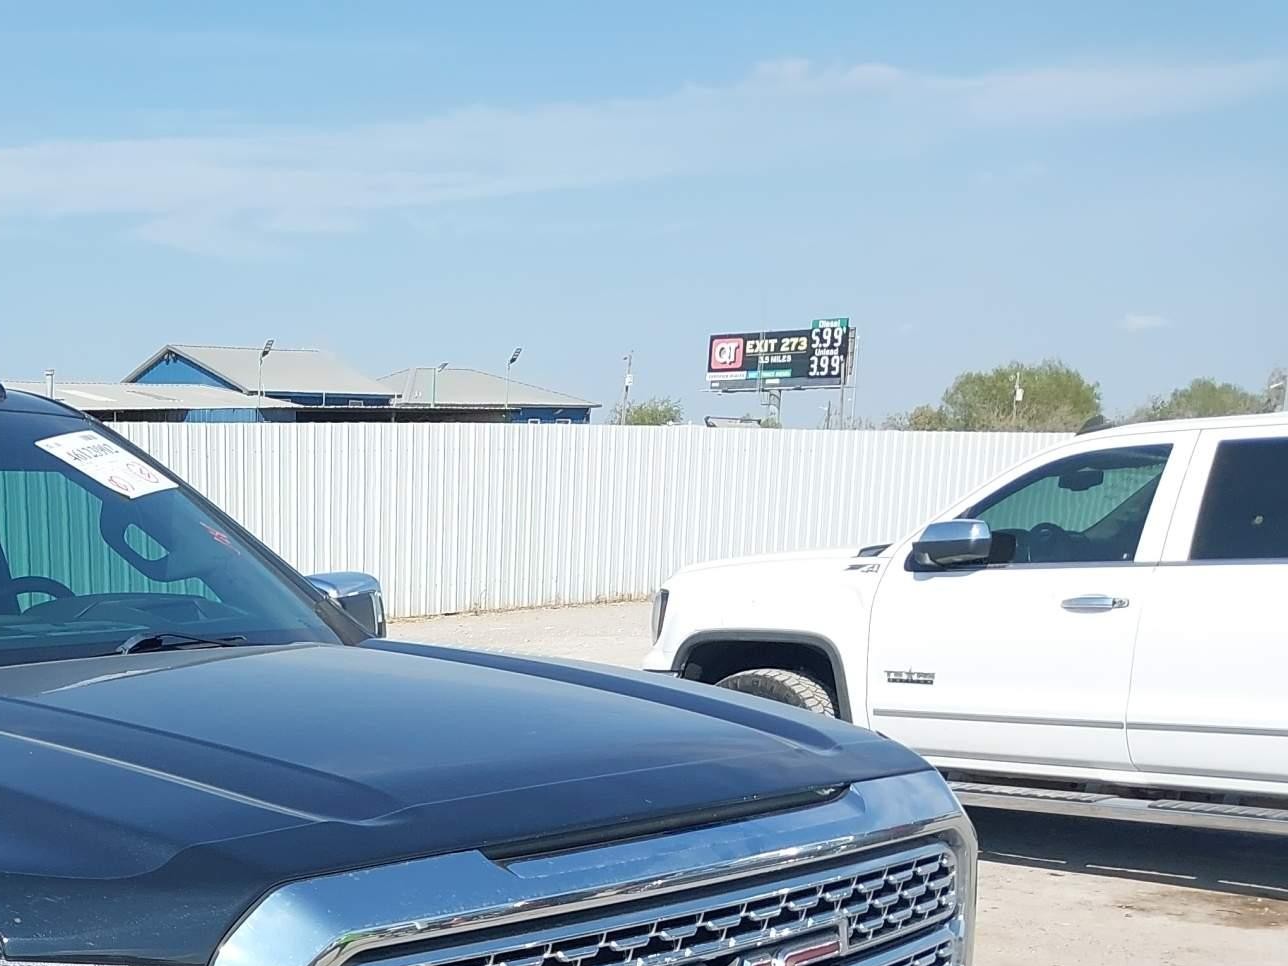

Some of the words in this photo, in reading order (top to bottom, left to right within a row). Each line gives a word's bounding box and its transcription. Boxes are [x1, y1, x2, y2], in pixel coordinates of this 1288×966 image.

[745, 339, 778, 353] EXIT
[780, 337, 808, 352] 273
[714, 342, 740, 365] QT
[770, 354, 792, 363] MILES
